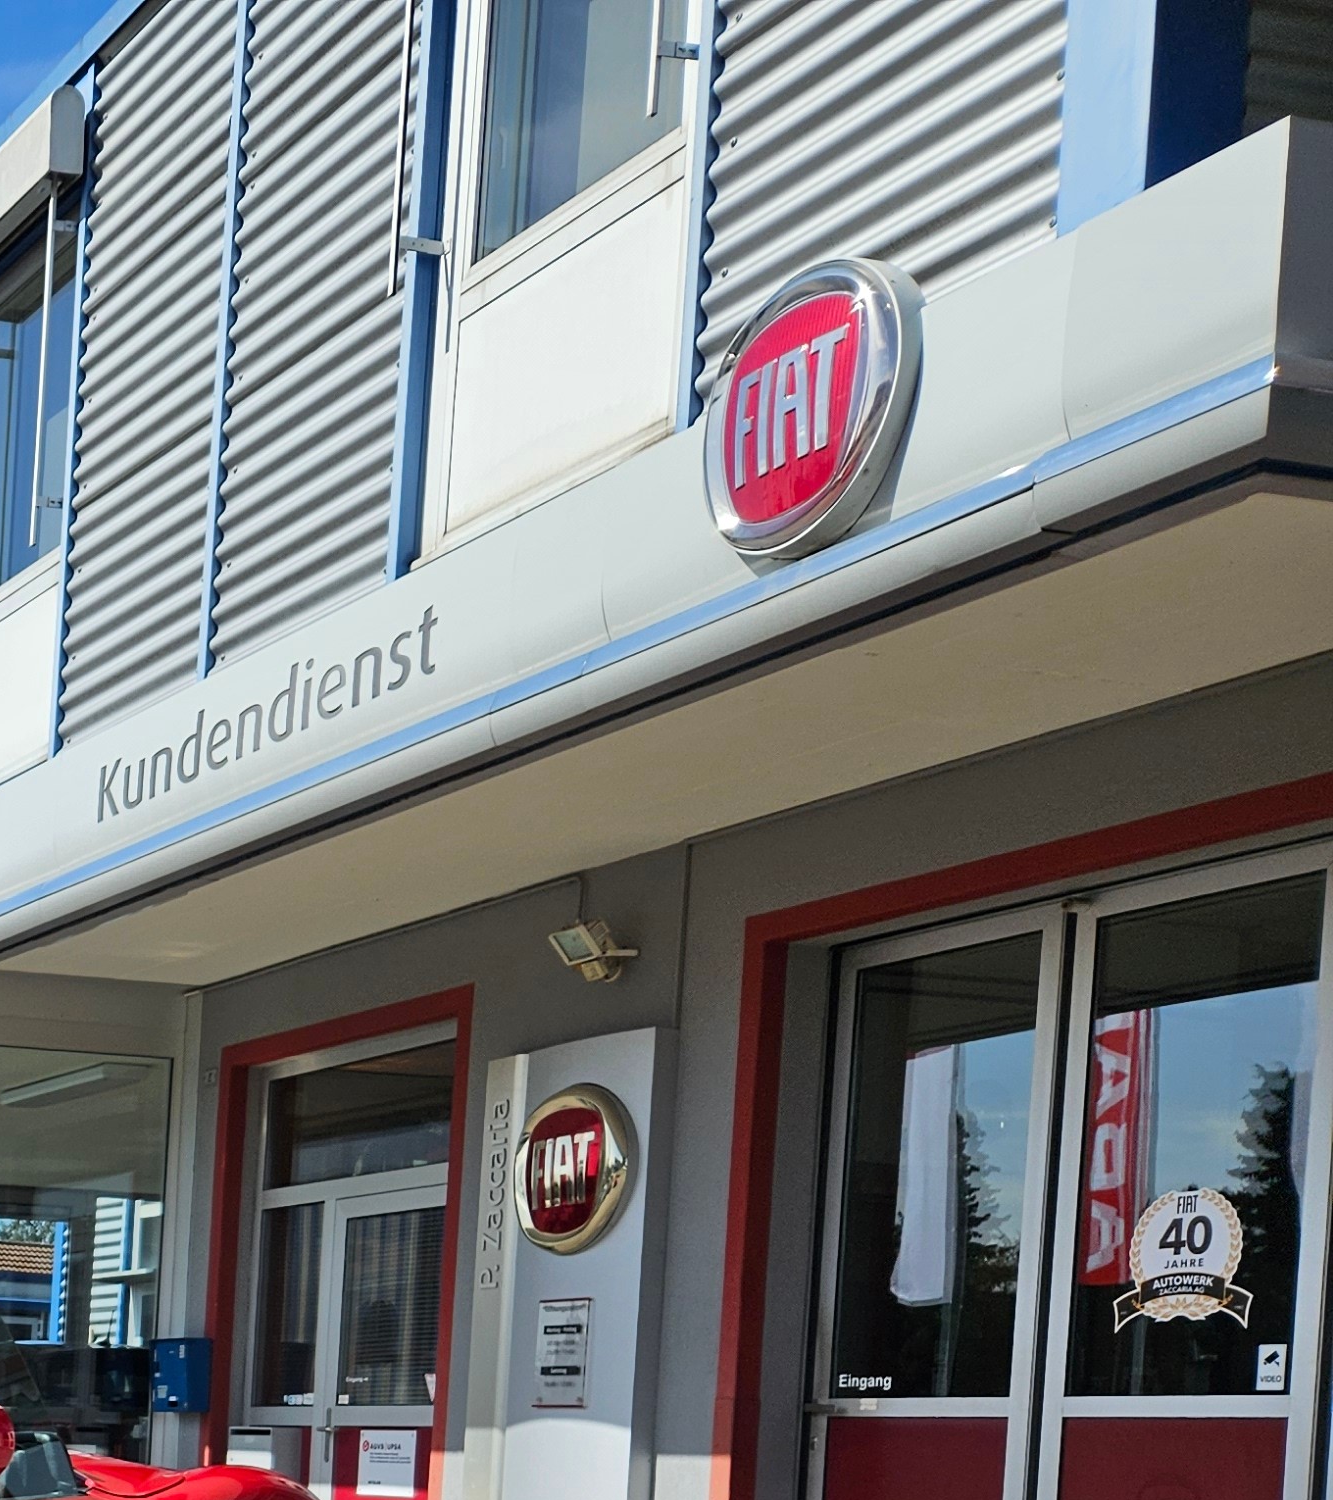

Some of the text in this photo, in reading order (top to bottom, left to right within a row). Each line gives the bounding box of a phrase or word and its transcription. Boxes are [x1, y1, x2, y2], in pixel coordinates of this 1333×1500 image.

[734, 322, 850, 490] FIAT
[96, 604, 439, 824] Kundendienst
[531, 1130, 596, 1210] FIAT
[480, 1098, 511, 1290] P. Zaccaria
[1177, 1195, 1199, 1214] FIAT
[1158, 1215, 1213, 1255] 40
[1164, 1257, 1205, 1269] JAHRE
[1153, 1274, 1215, 1290] AUTOWERK
[1158, 1285, 1193, 1296] ZACCARIA
[838, 1373, 893, 1391] Eingang
[1260, 1374, 1282, 1383] VIDEO
